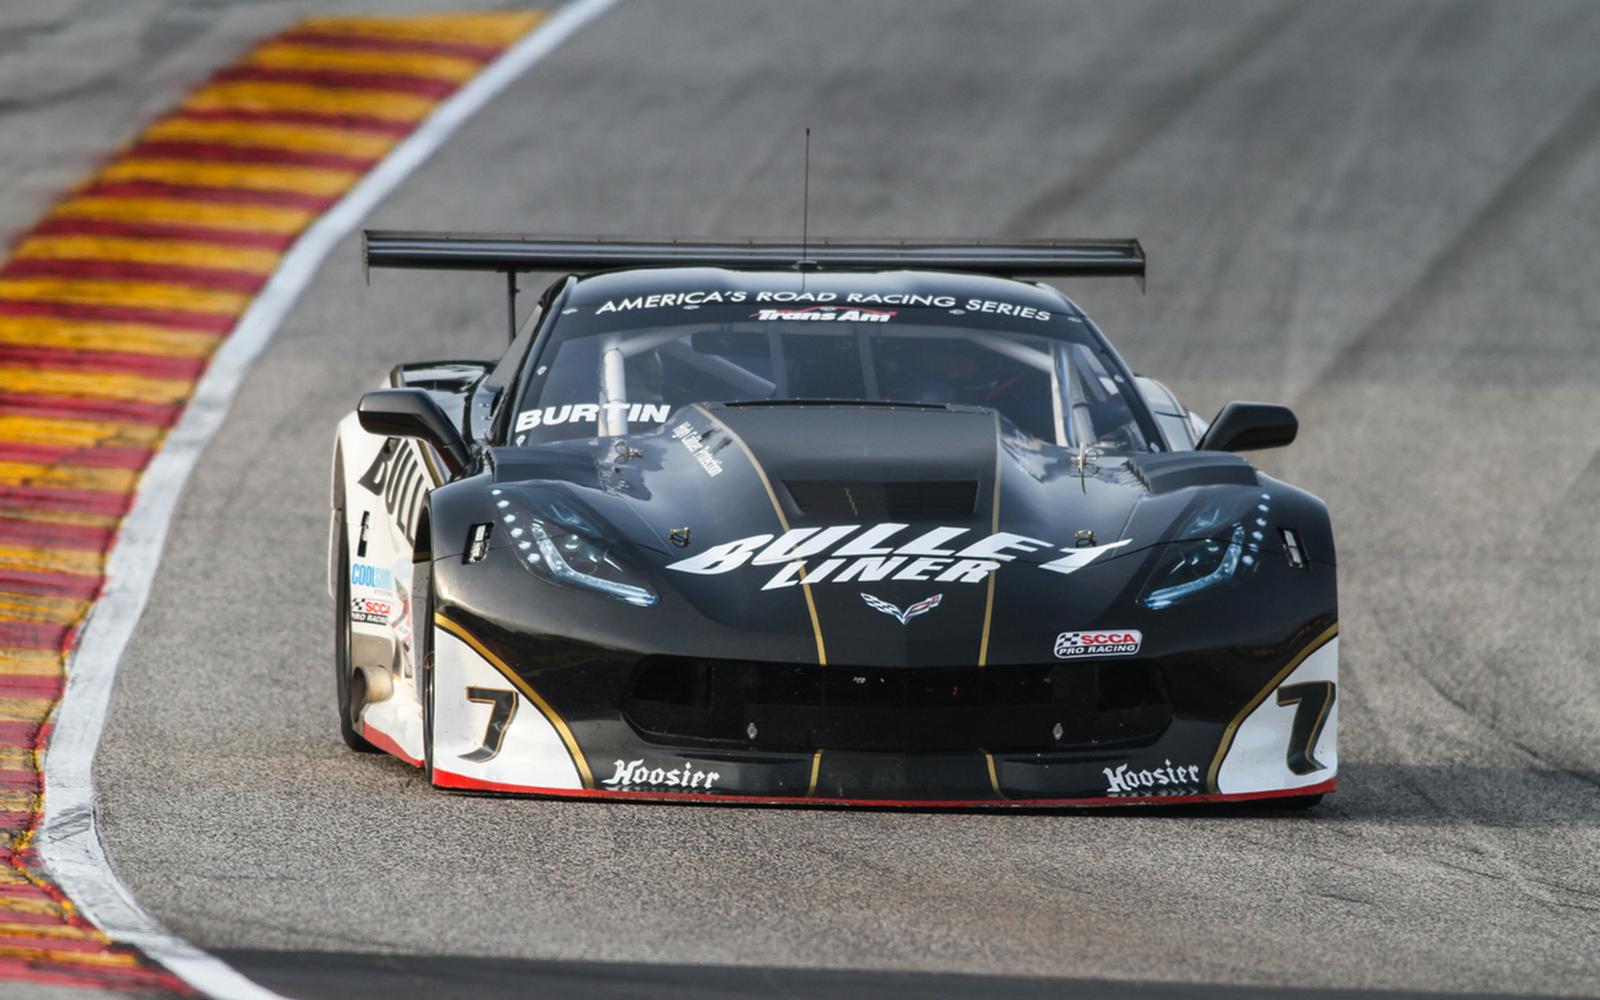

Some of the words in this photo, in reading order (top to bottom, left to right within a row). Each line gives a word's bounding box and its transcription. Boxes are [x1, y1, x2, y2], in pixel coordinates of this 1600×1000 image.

[595, 291, 748, 315] AMERICA'S
[756, 291, 838, 303] ROAD
[846, 293, 956, 308] RACING
[965, 299, 1051, 321] SERIES
[757, 309, 838, 322] Trans
[838, 310, 891, 322] Am
[514, 403, 671, 433] BURTIN
[357, 436, 430, 551] BULL
[665, 522, 1133, 575] BULLET
[760, 556, 1001, 591] LINER
[1058, 646, 1085, 655] PRO
[1087, 644, 1136, 654] RACING
[1080, 633, 1137, 645] SCCA
[456, 685, 520, 763] 7
[1276, 680, 1336, 776] 7
[602, 759, 720, 788] Hoosier
[1102, 759, 1200, 793] Hoosier
